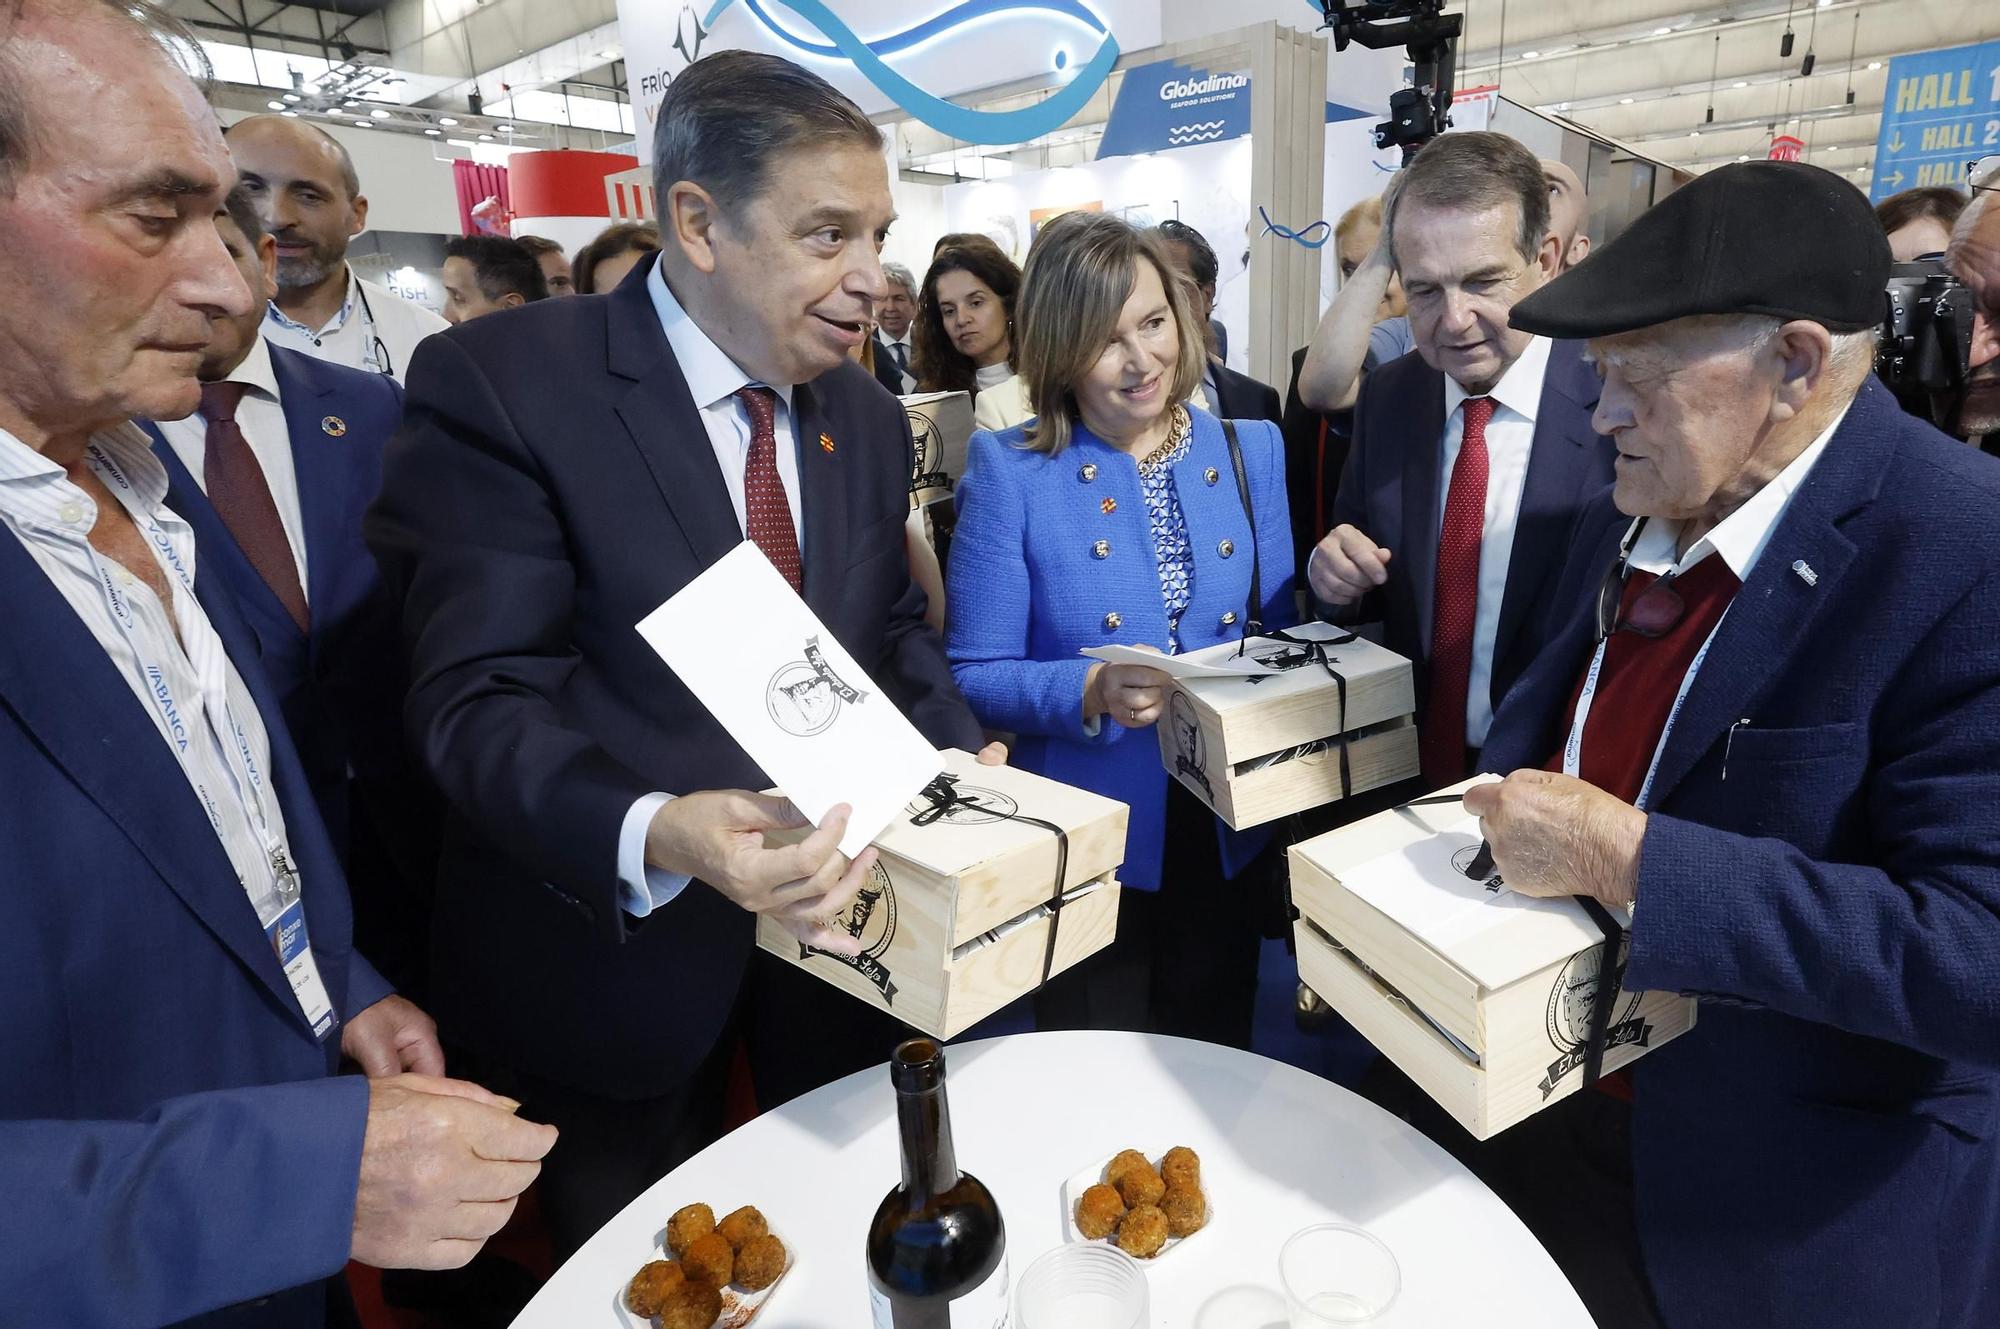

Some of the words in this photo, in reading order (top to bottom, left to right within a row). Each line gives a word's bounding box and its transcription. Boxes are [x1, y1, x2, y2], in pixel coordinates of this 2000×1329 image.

[1170, 98, 1199, 109] SEAFOOD
[1199, 92, 1236, 104] SOLUTIONS
[1895, 69, 1975, 114] HALL
[1920, 122, 1975, 152] HALL
[1982, 119, 2000, 146] 2
[1557, 1052, 1573, 1077] El
